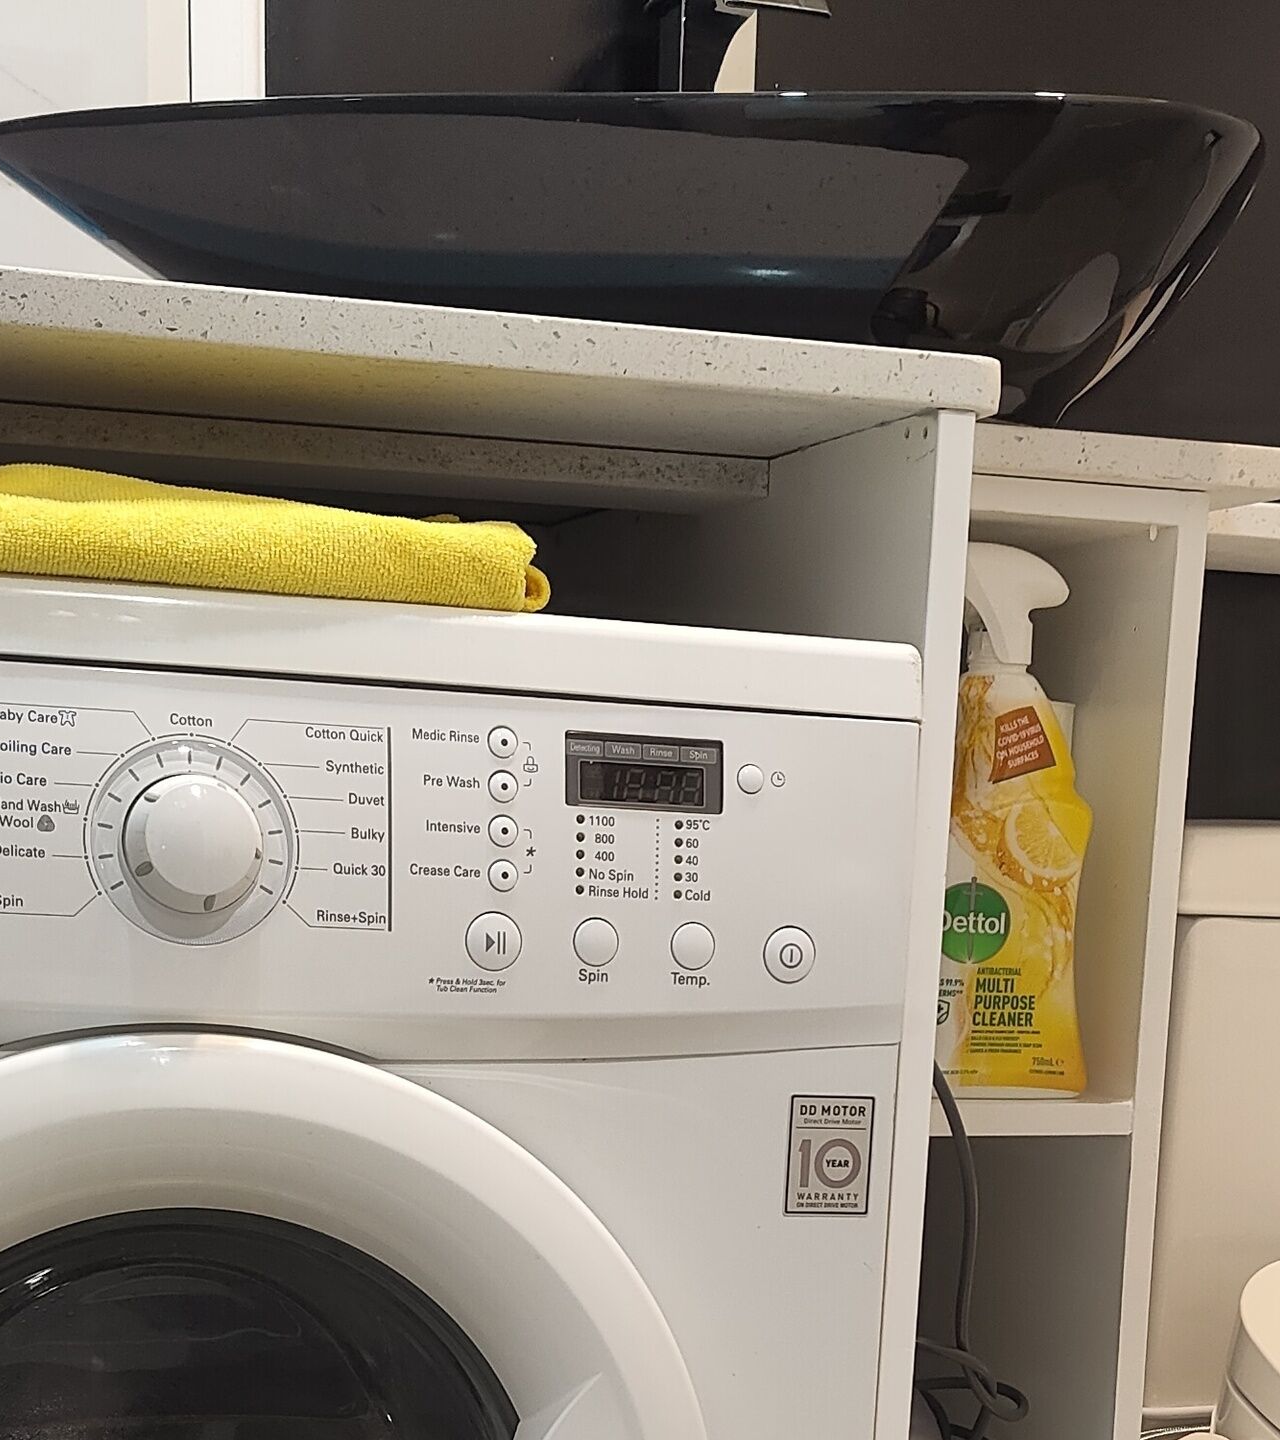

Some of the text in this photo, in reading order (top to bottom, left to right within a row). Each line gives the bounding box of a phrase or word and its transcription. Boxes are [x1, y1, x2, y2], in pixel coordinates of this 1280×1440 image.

[27, 709, 59, 724] Care
[169, 712, 213, 728] Cotton
[999, 719, 1018, 733] KILLS
[305, 726, 384, 743] Cotton Quick
[411, 727, 480, 744] Medic Rinse
[41, 741, 72, 756] Care
[611, 744, 635, 756] Wash
[649, 748, 674, 758] Rinse
[1007, 735, 1045, 757] HOUSEHOLD
[689, 750, 708, 761] Spin
[1007, 749, 1040, 769] SURFACES
[325, 759, 385, 776] Synthetic
[16, 772, 48, 787] Care
[423, 774, 481, 789] Pre Wash
[27, 799, 62, 813] Wash
[347, 792, 386, 806] Duvet
[425, 819, 481, 834] Intensive
[588, 815, 616, 828] 1100
[350, 827, 386, 842] Bulky
[594, 833, 615, 845] 800
[685, 837, 700, 850] 60
[594, 851, 615, 863] 400
[685, 855, 699, 867] 40
[332, 862, 387, 877] Quick 30
[409, 862, 481, 879] Crease Care
[588, 868, 634, 883] No Spin
[684, 872, 699, 884] 30
[588, 885, 650, 900] Rinse Hold
[684, 889, 711, 902] Cold
[316, 909, 387, 925] Rinse+Spin
[577, 968, 609, 984] Spin
[976, 967, 1022, 976] ANTIBACTERIAL
[670, 971, 711, 988] Temp.
[975, 977, 1015, 994] MULTI
[469, 986, 498, 994] Function
[973, 994, 1036, 1011] PURPOSE
[972, 1011, 1034, 1027] CLEANER
[799, 1104, 867, 1117] DD MOTOR
[803, 1117, 823, 1125] Direct
[798, 1138, 862, 1189] 10
[825, 1159, 851, 1169] YEAR
[796, 1192, 859, 1201] WARRANTY
